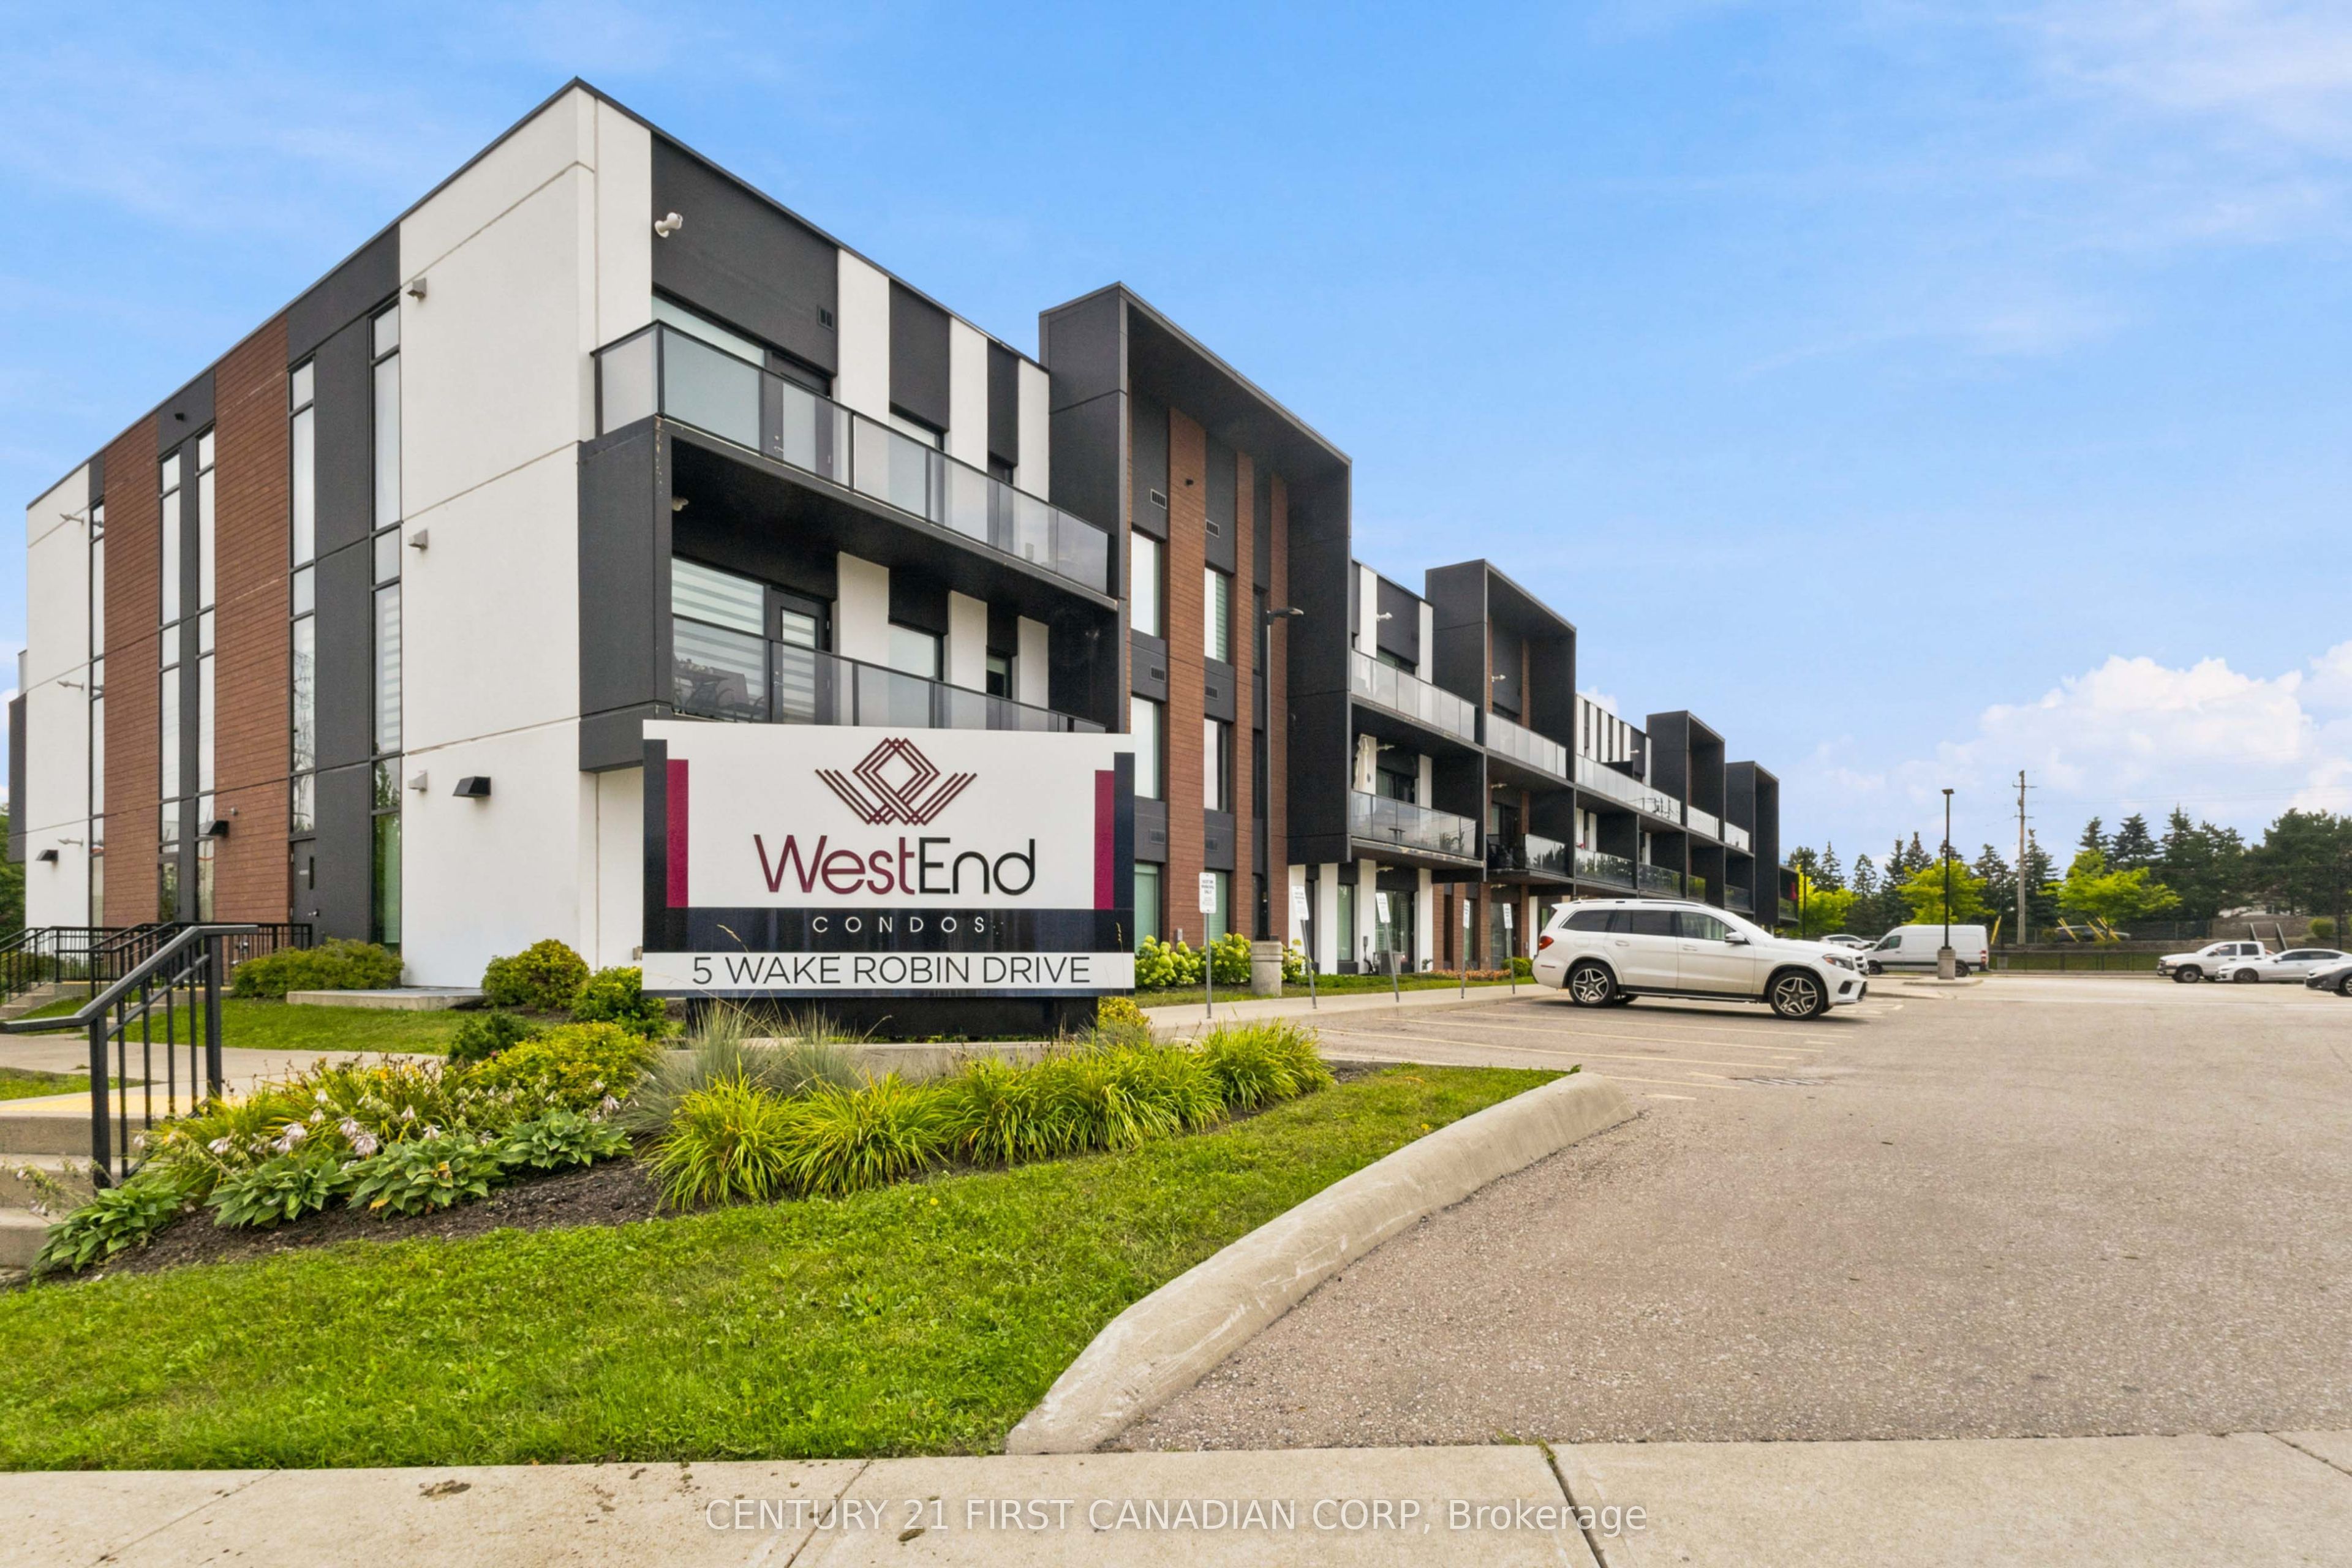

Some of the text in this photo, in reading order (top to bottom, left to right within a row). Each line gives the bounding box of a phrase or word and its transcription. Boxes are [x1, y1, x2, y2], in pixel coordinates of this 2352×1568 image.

[753, 834, 1036, 896] WestEnd
[812, 916, 985, 933] CONDOS
[692, 956, 1091, 985] 5 WAKE ROBIN DRIVE
